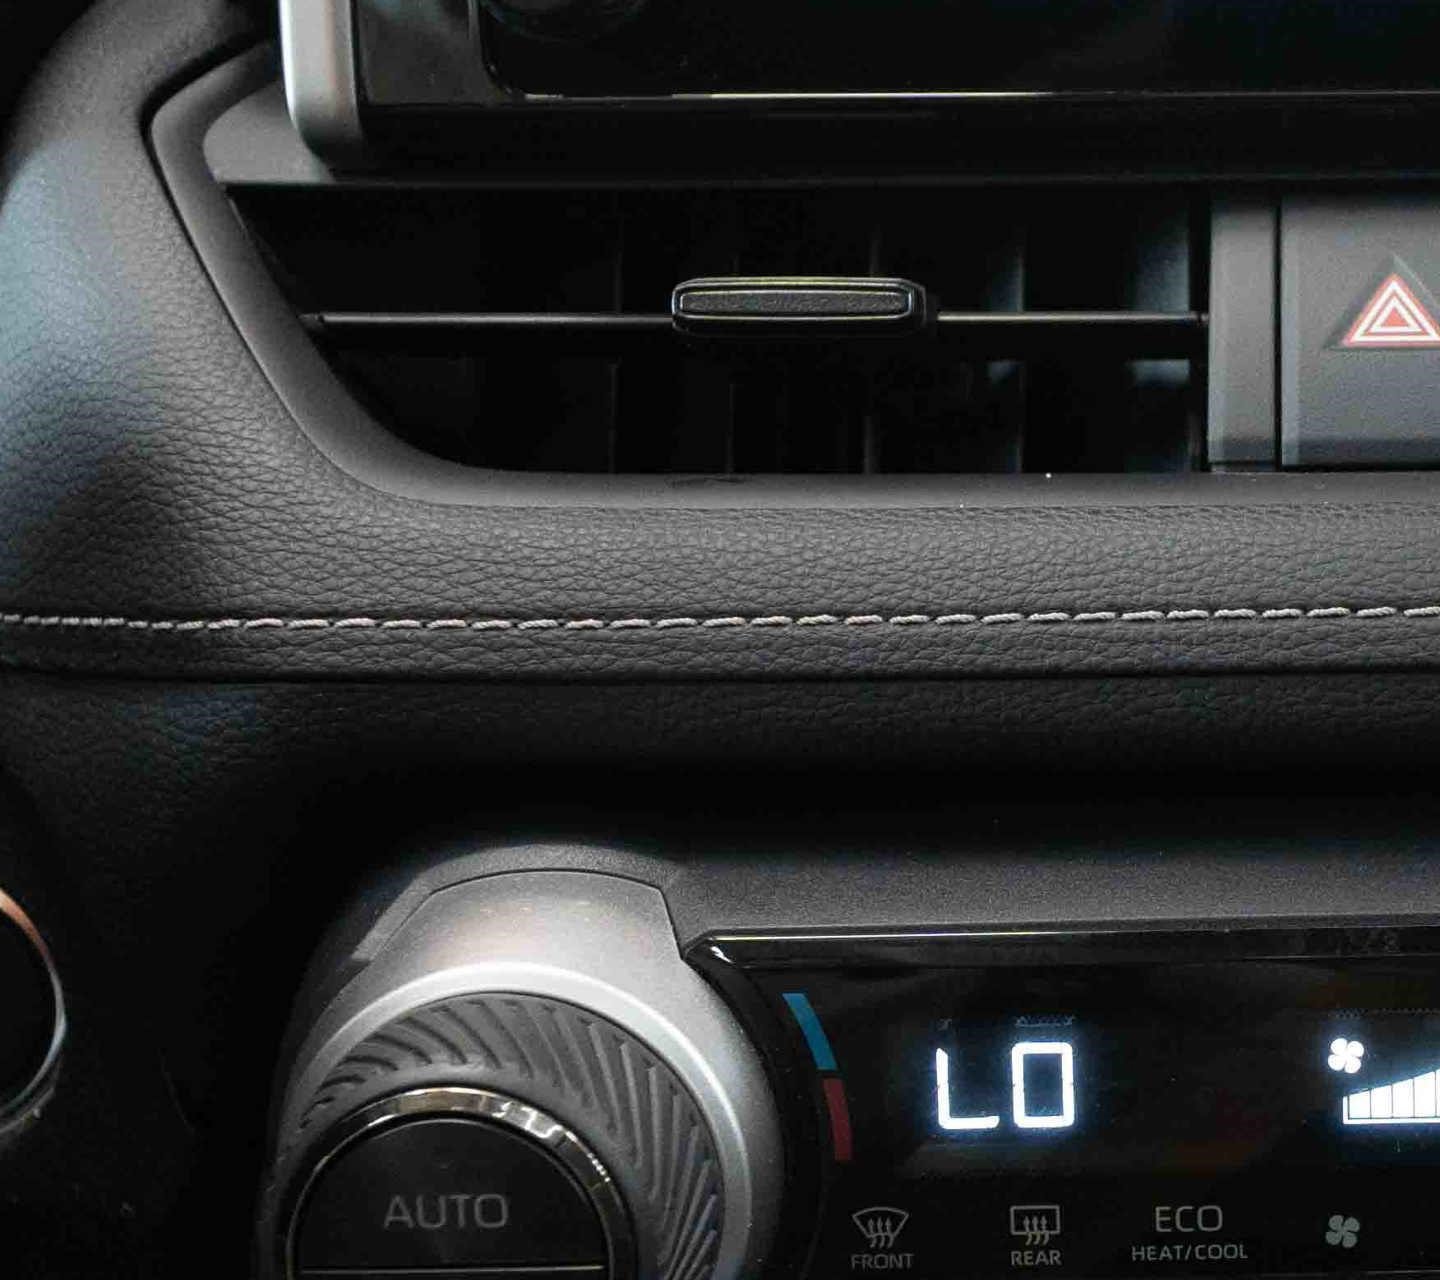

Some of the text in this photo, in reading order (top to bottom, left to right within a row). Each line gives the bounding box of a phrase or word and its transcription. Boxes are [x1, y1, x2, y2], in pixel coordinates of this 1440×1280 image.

[935, 1040, 1076, 1131] LO
[383, 1192, 510, 1231] AUTO
[1154, 1203, 1224, 1234] ECO
[850, 1251, 915, 1271] FRONT
[1010, 1248, 1062, 1267] REAR
[1131, 1242, 1249, 1263] HEAT/COOL
